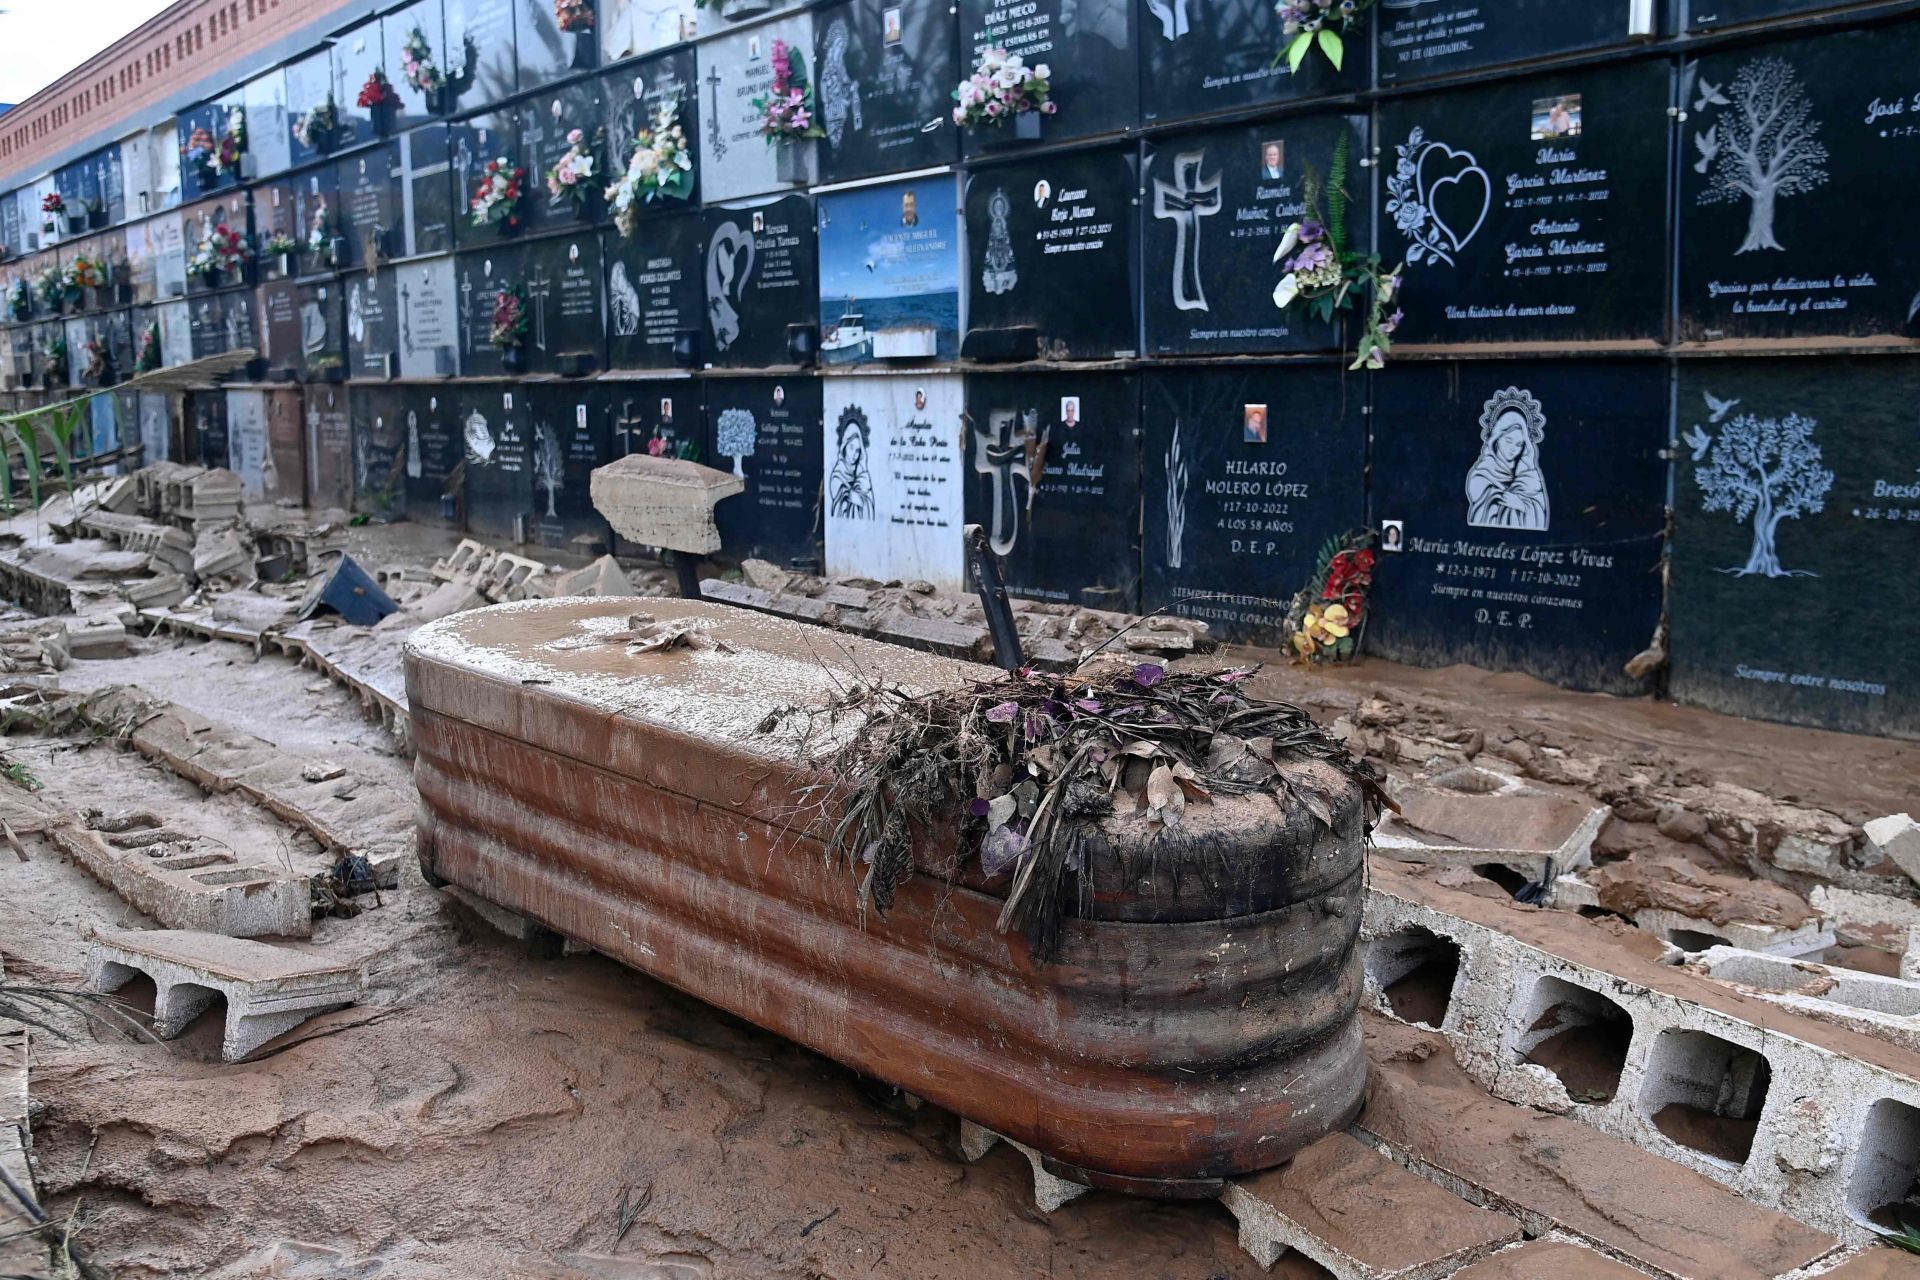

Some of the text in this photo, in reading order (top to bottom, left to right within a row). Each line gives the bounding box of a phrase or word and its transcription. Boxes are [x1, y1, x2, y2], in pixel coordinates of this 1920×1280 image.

[1864, 97, 1904, 124] José
[1536, 147, 1576, 164] María
[1505, 173, 1544, 195] García
[1504, 243, 1543, 264] García
[1708, 280, 1748, 298] Gracias
[1749, 282, 1769, 296] por
[1833, 274, 1846, 288] la
[1467, 305, 1504, 318] historia
[1505, 304, 1517, 317] de
[1518, 306, 1544, 316] amor
[1732, 300, 1744, 313] la
[1788, 302, 1798, 316] y
[1800, 297, 1810, 311] el
[1226, 460, 1288, 476] HILARIO
[1205, 479, 1309, 498] MOLERO LÓPEZ
[1217, 519, 1294, 534] A LOS 58 AÑOS
[1231, 540, 1280, 555] D. E. P.
[1409, 537, 1614, 569] María Mercedes López Vivas
[1172, 586, 1214, 600] SIEMPRE
[1431, 583, 1469, 600] Siempre
[1471, 588, 1484, 598] en
[1486, 590, 1529, 603] nuestros
[1176, 603, 1189, 615] EN
[1191, 604, 1238, 622] NUESTRO
[1734, 663, 1887, 696] Siempre entre nosotros
